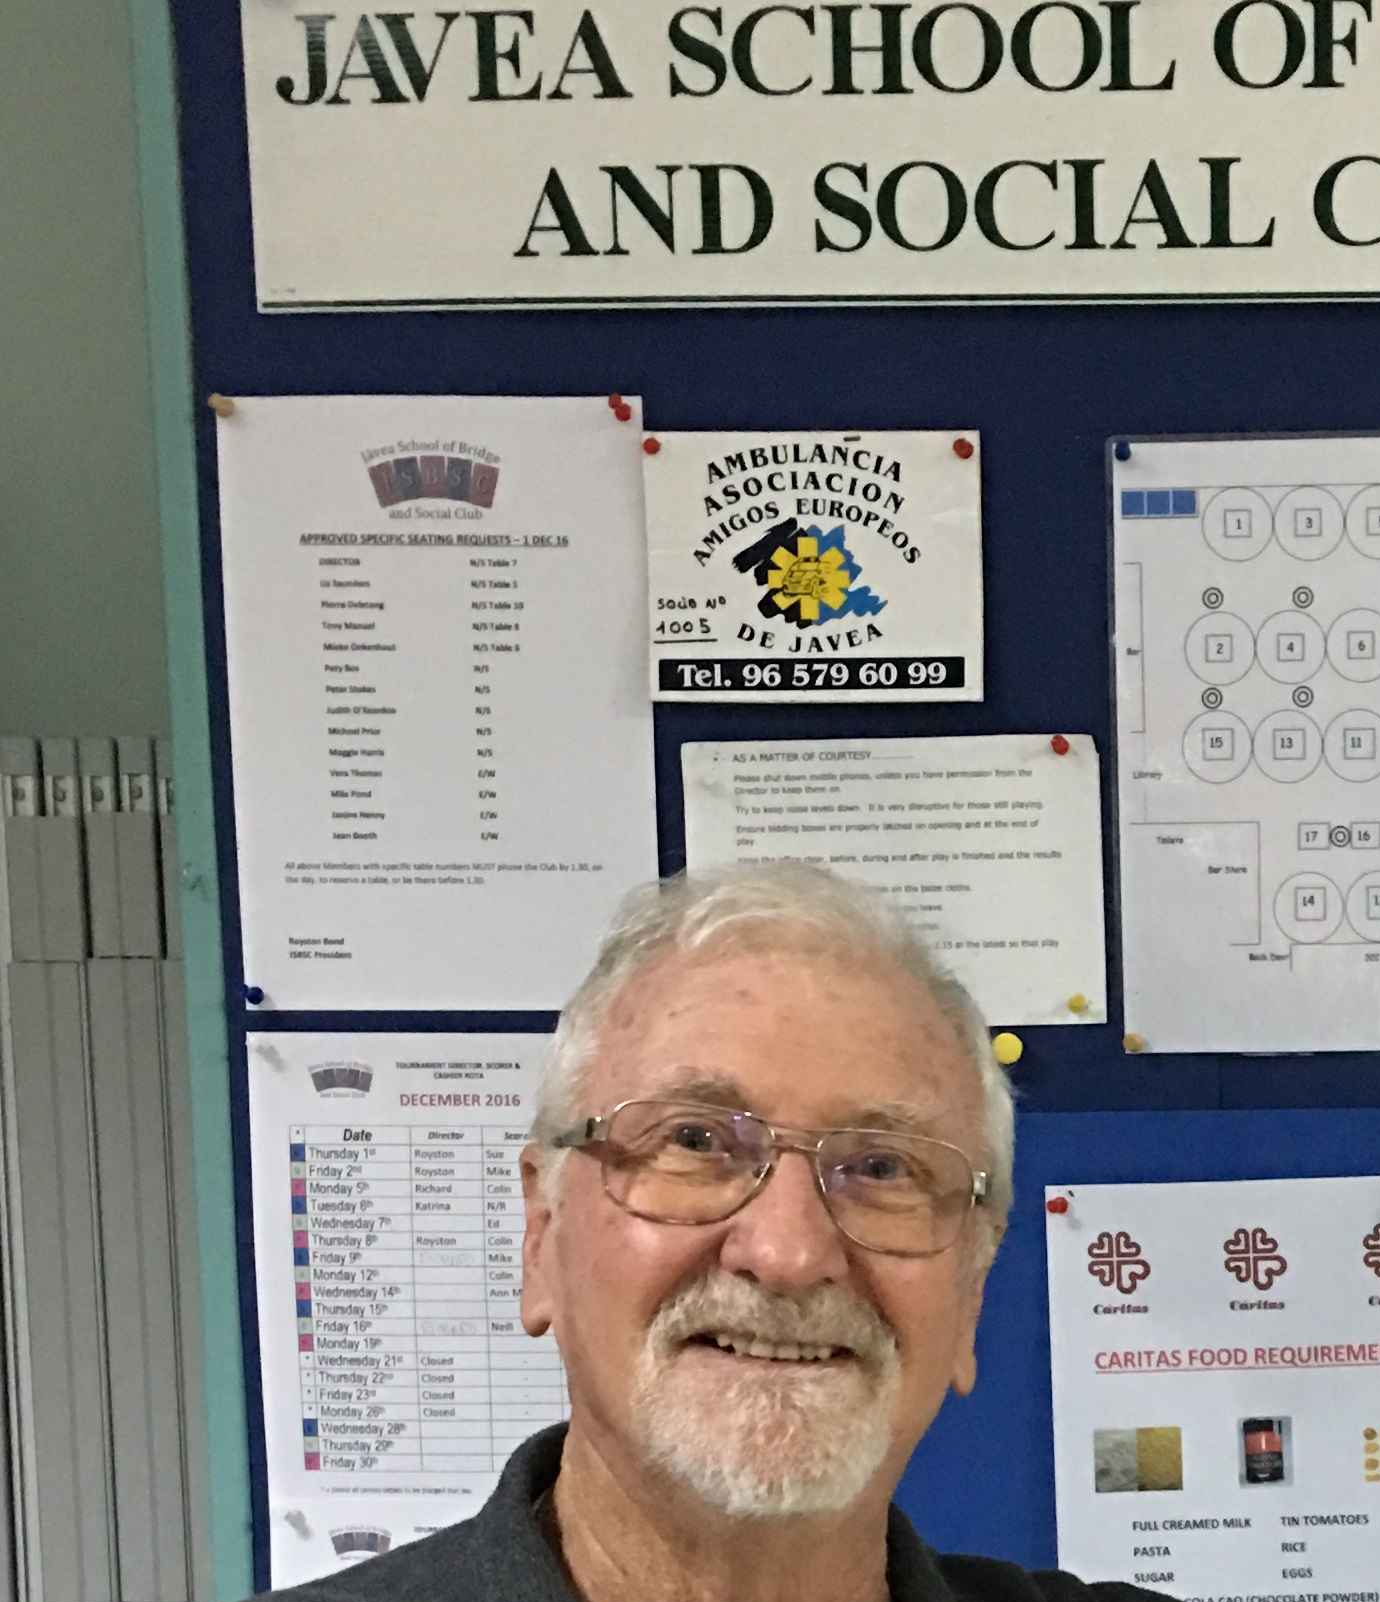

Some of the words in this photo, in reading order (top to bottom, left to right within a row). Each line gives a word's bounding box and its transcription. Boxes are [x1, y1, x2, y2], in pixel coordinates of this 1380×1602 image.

[276, 8, 633, 106] JAVEA
[668, 2, 1175, 97] SCHOOL
[1212, 0, 1371, 89] OF
[513, 163, 773, 257] AND
[814, 156, 1275, 253] SOCIAL
[397, 440, 439, 452] School
[443, 441, 456, 452] of
[458, 441, 501, 464] Bridge
[707, 443, 901, 484] AMBULANCIA
[703, 471, 905, 516] ASOCIACION
[389, 507, 412, 519] and
[415, 507, 451, 519] Social
[454, 507, 483, 519] Club
[1236, 518, 1241, 529] 1
[1306, 517, 1312, 528] 3
[693, 501, 780, 567] AMIGOS
[796, 498, 921, 564] EUROPEOS
[300, 533, 358, 544] APPROVED
[360, 533, 405, 544] SPECIFIC
[407, 533, 453, 544] SEATING
[457, 534, 511, 545] REQUESTS
[523, 535, 530, 545] 1
[532, 535, 553, 545] DEC
[556, 535, 568, 545] 16
[737, 622, 775, 650] DE
[789, 622, 883, 653] JAVEA
[1216, 642, 1223, 654] 2
[1286, 642, 1294, 652] 4
[1358, 640, 1365, 651] 6
[677, 664, 731, 687] Tel.
[742, 663, 781, 686] 96
[792, 663, 848, 686] 579
[859, 662, 897, 685] 60
[908, 662, 946, 684] 99
[1210, 736, 1223, 748] 15
[1280, 737, 1293, 748] 13
[1350, 736, 1361, 748] 11
[732, 754, 746, 762] AS
[759, 752, 798, 761] MATTER
[802, 751, 814, 761] OF
[1305, 830, 1318, 842] 17
[1358, 830, 1370, 841] 16
[1302, 895, 1314, 906] 14
[400, 1093, 480, 1106] DECEMBER
[485, 1094, 520, 1106] 2016
[343, 1128, 372, 1141] Date
[428, 1131, 464, 1140] Director
[308, 1146, 359, 1161] Thursday
[414, 1149, 454, 1160] Royston
[486, 1150, 504, 1158] Sue
[309, 1164, 342, 1179] Friday
[414, 1166, 454, 1177] Royston
[486, 1167, 510, 1176] Mike
[310, 1182, 352, 1196] Monday
[415, 1184, 451, 1193] Richard
[486, 1184, 511, 1193] Colin
[310, 1199, 356, 1214] Tuesday
[415, 1202, 450, 1210] Katrina
[310, 1217, 374, 1231] Wednesday
[487, 1219, 499, 1228] Ed
[311, 1233, 361, 1248] Thursday
[416, 1236, 456, 1246] Royston
[312, 1251, 345, 1265] Friday
[420, 1356, 453, 1365] Closed
[1094, 1350, 1181, 1370] CARITAS
[1188, 1348, 1247, 1367] FOOD
[1132, 1520, 1158, 1531] FULL
[1162, 1518, 1219, 1530] CREAMED
[1222, 1518, 1251, 1528] MILK
[1280, 1516, 1299, 1526] TIN
[1303, 1514, 1368, 1526] TOMATOES
[1133, 1546, 1170, 1556] PASTA
[1281, 1542, 1306, 1552] RICE
[1134, 1572, 1174, 1582] SUGAR
[1282, 1567, 1312, 1578] EGGS
